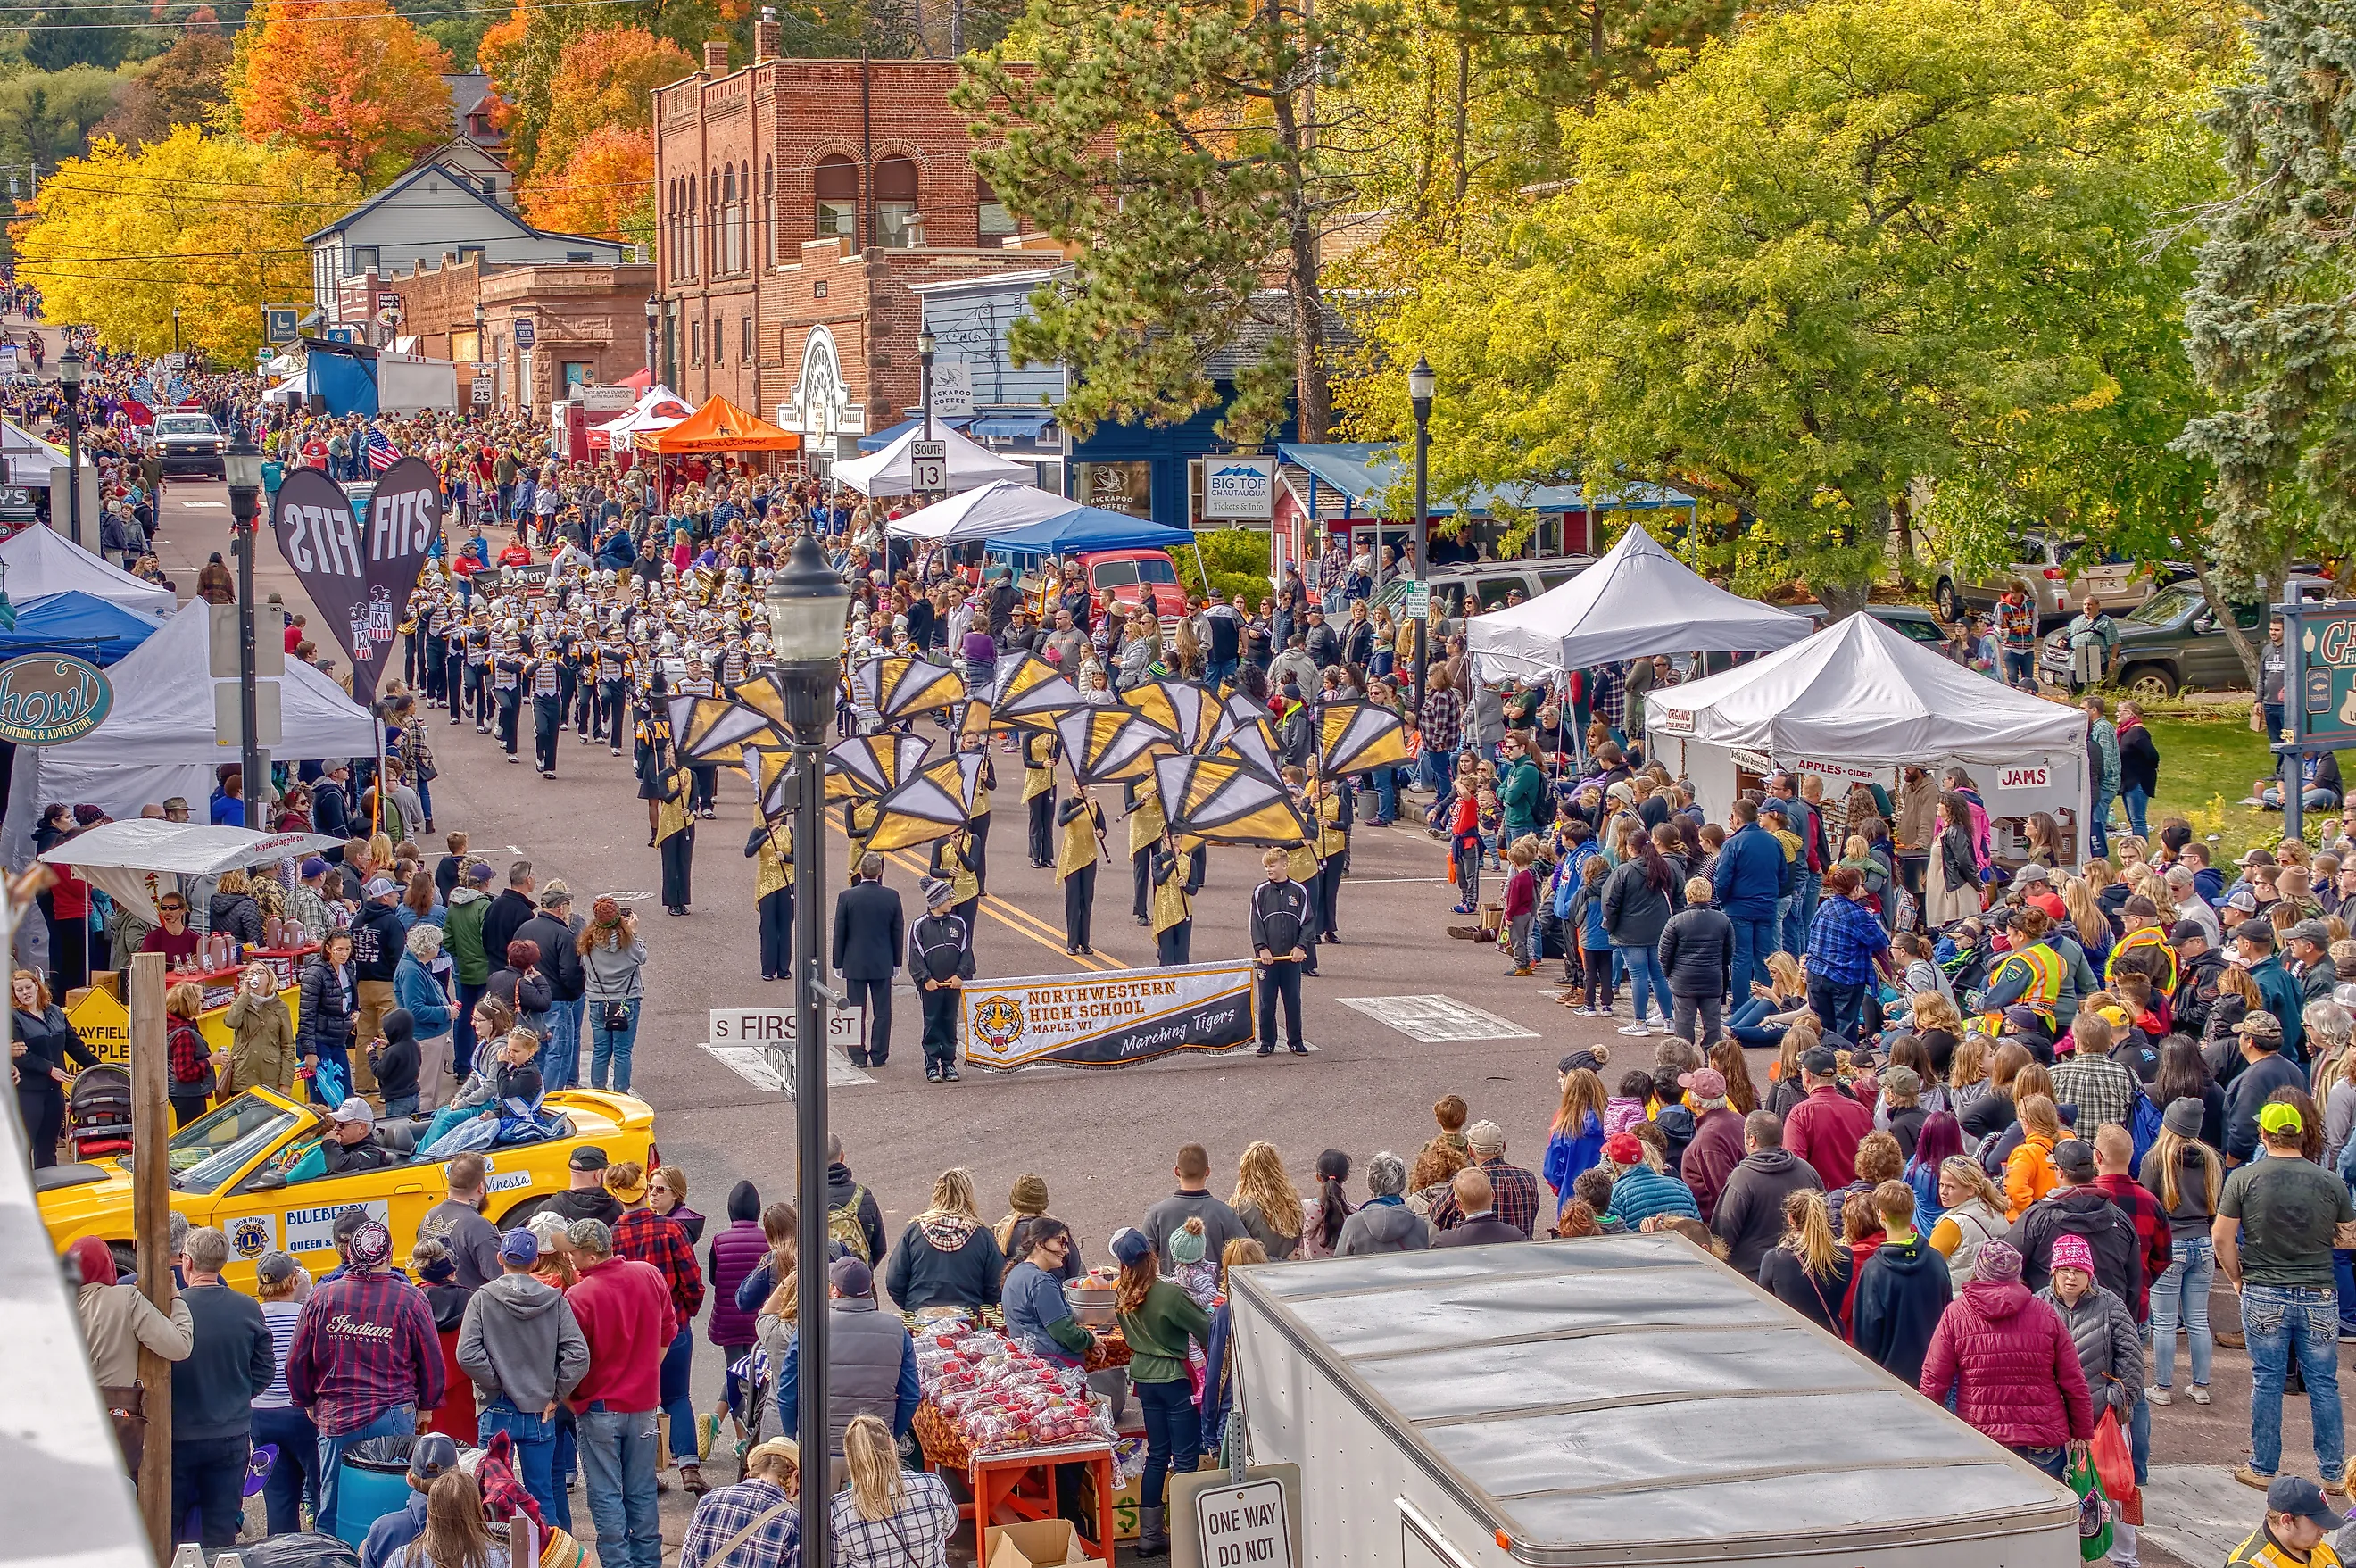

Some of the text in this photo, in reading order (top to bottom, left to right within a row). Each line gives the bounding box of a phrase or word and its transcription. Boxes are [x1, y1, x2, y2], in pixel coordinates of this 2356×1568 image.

[474, 391, 491, 401] 25
[696, 437, 773, 449] smartwool
[914, 444, 943, 455] SOUTH
[918, 466, 939, 485] 13
[1212, 477, 1267, 489] BIG TOP
[1090, 494, 1133, 504] KICKAPOO
[1211, 489, 1266, 497] CHAUTAUQUA
[1213, 502, 1264, 510] Tickets & Info
[371, 488, 436, 561] FITS
[478, 579, 500, 591] VOTE
[1409, 583, 1413, 591] 2
[371, 612, 389, 629] USA
[0, 670, 89, 728] howl
[1668, 709, 1691, 722] ORGANIC
[0, 715, 95, 740] CLOTHING & ADVENTURE
[653, 721, 670, 739] N
[1796, 759, 1842, 776] APPLES
[1847, 768, 1873, 779] CIDER
[2002, 768, 2046, 786] JAMS
[255, 839, 278, 852] bayfield
[279, 834, 295, 846] apple
[1028, 980, 1176, 1005] NORTHWESTERN
[1029, 1000, 1145, 1023] HIGH SCHOOL
[72, 1026, 129, 1040] AYFIEL
[716, 1015, 855, 1040] S FIRS ST
[1032, 1021, 1092, 1034] MAPLE, WI
[1120, 1008, 1236, 1056] Marching Tigers
[87, 1044, 129, 1059] PPLE
[486, 1175, 530, 1191] Vinessa
[234, 1216, 266, 1230] IRON RIVER
[239, 1224, 261, 1236] LIONS
[246, 1233, 257, 1248] L
[289, 1239, 333, 1252] QUEEN &
[356, 1225, 368, 1256] INDIAN
[326, 1314, 393, 1339] Indian
[328, 1333, 389, 1345] MOTORCYCLE
[1208, 1502, 1276, 1535] ONE WAY
[1218, 1537, 1274, 1567] DO NOT
